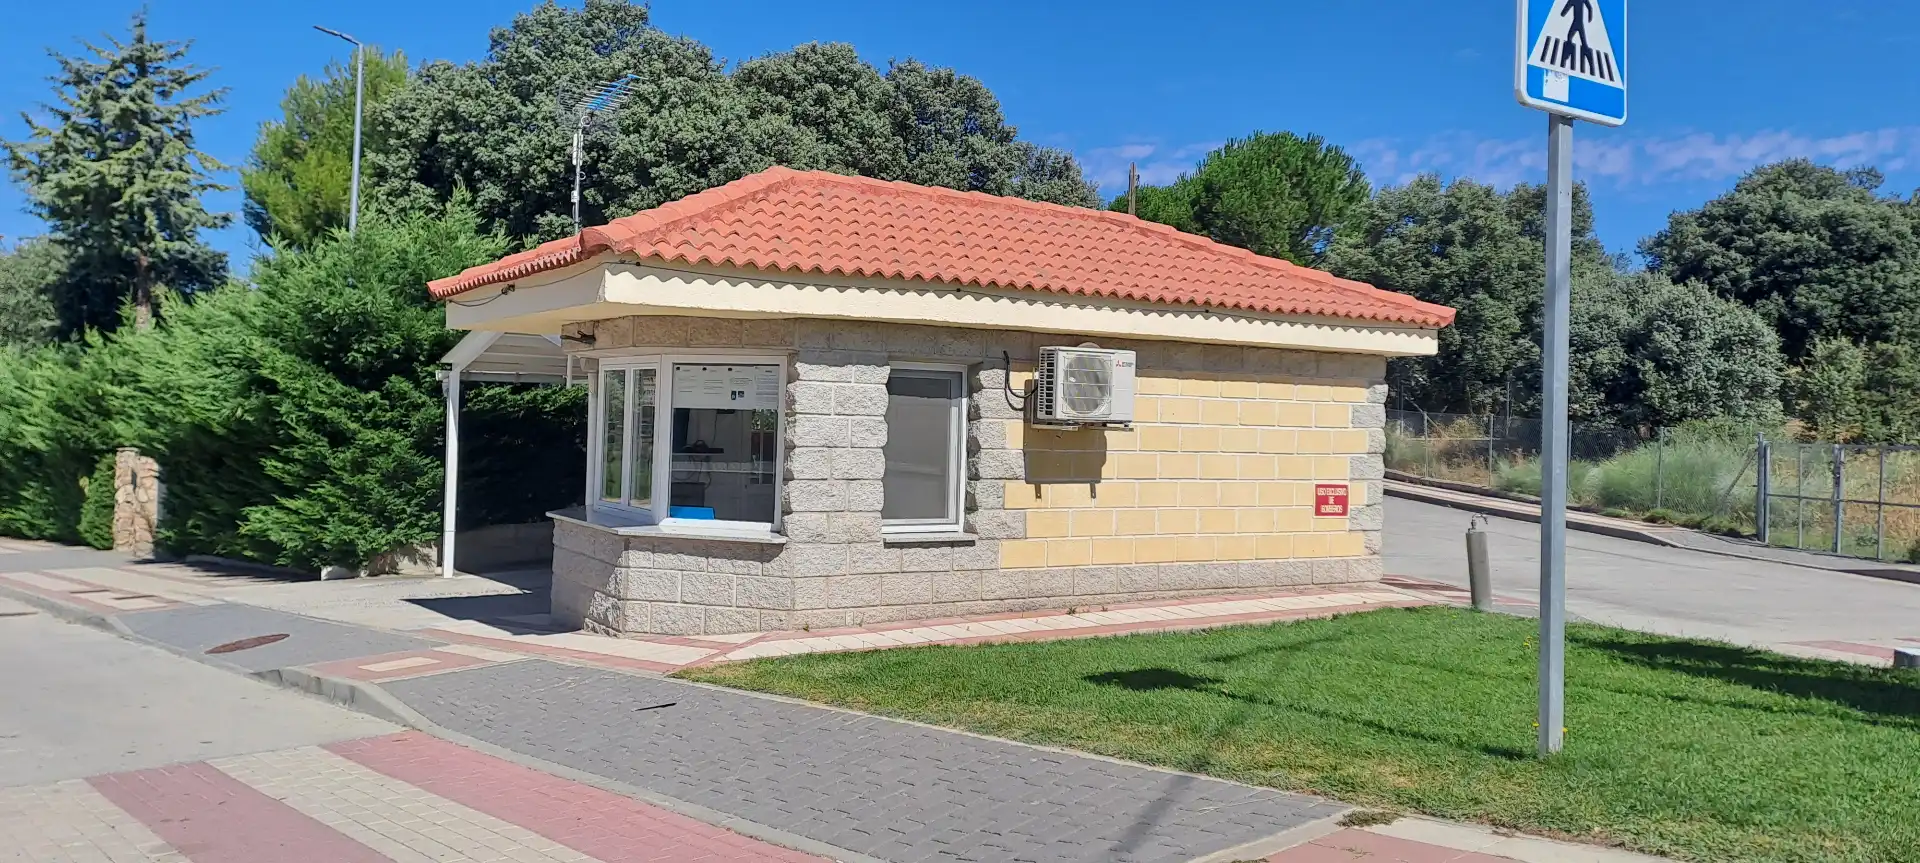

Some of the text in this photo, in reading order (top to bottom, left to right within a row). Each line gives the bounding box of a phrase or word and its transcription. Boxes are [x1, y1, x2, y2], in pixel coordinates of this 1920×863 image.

[1317, 487, 1347, 496] USO EXCLUSIVO
[1328, 496, 1335, 504] DE
